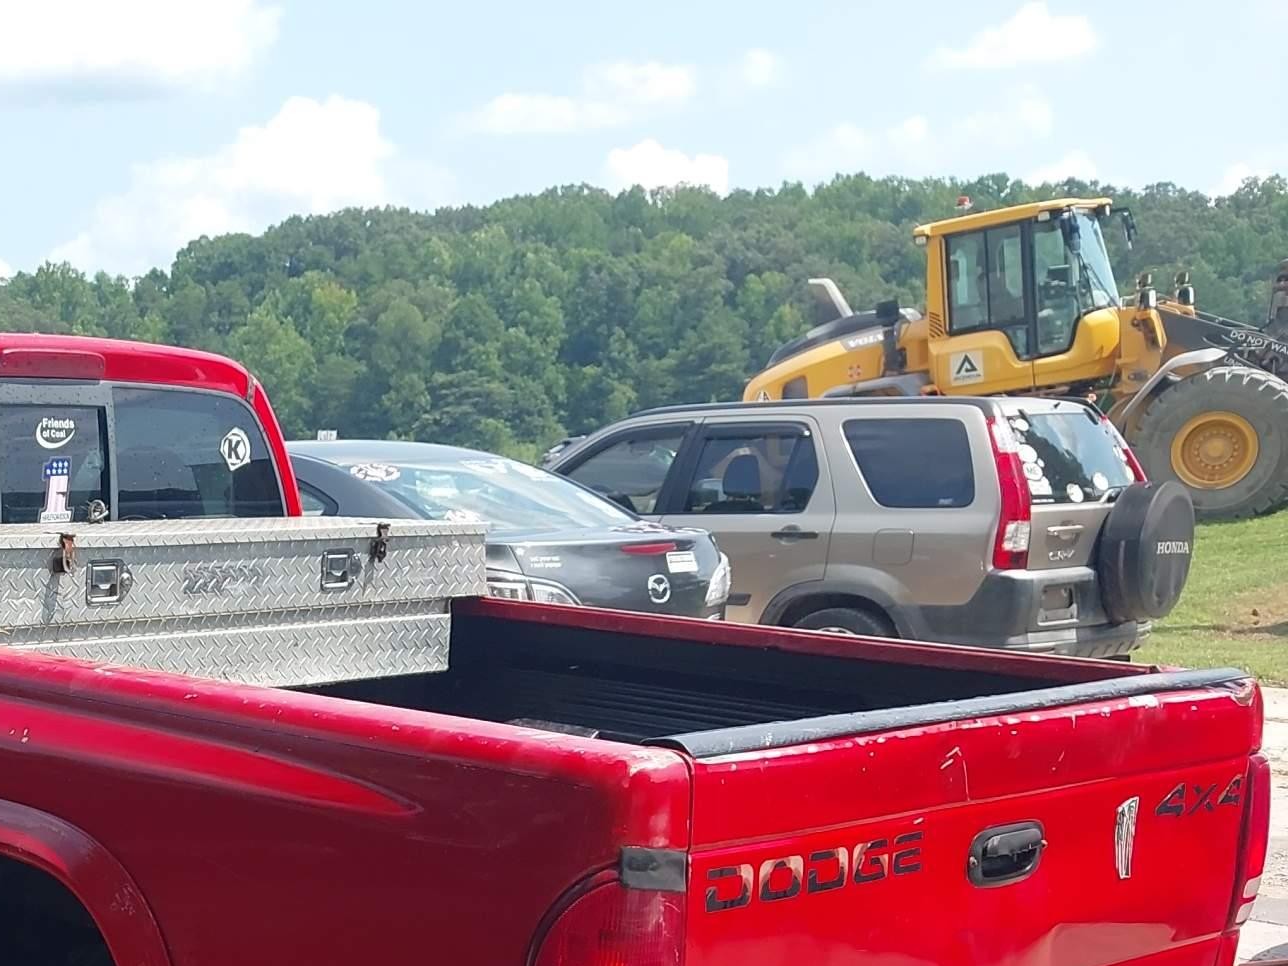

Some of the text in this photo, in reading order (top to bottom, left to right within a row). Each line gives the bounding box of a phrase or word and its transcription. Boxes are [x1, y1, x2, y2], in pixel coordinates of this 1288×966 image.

[1230, 330, 1288, 355] DO NOT WA
[42, 418, 75, 429] Friends
[42, 430, 66, 438] of Coal
[226, 438, 242, 461] K
[1156, 541, 1190, 554] HONDA
[705, 831, 923, 913] DODGE
